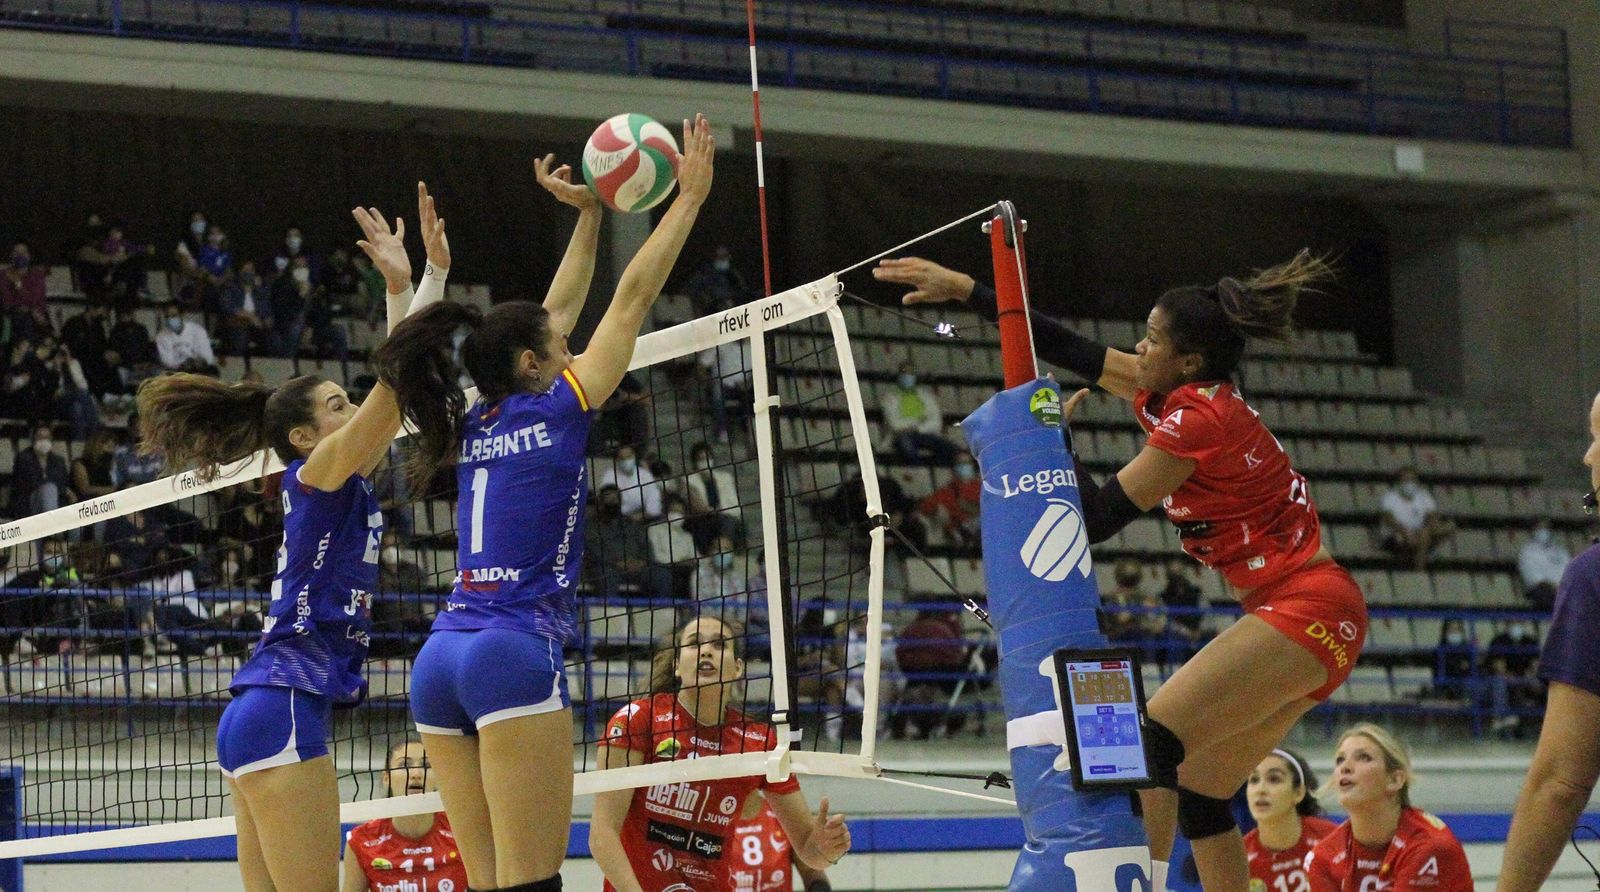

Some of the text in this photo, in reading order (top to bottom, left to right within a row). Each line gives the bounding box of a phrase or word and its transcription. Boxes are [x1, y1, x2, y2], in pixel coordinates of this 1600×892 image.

[719, 302, 784, 335] rfevbom
[458, 421, 553, 464] LASANTE
[78, 499, 117, 520] rfevb.com
[470, 467, 489, 555] 1
[0, 525, 22, 541] b.com
[742, 835, 764, 866] 8
